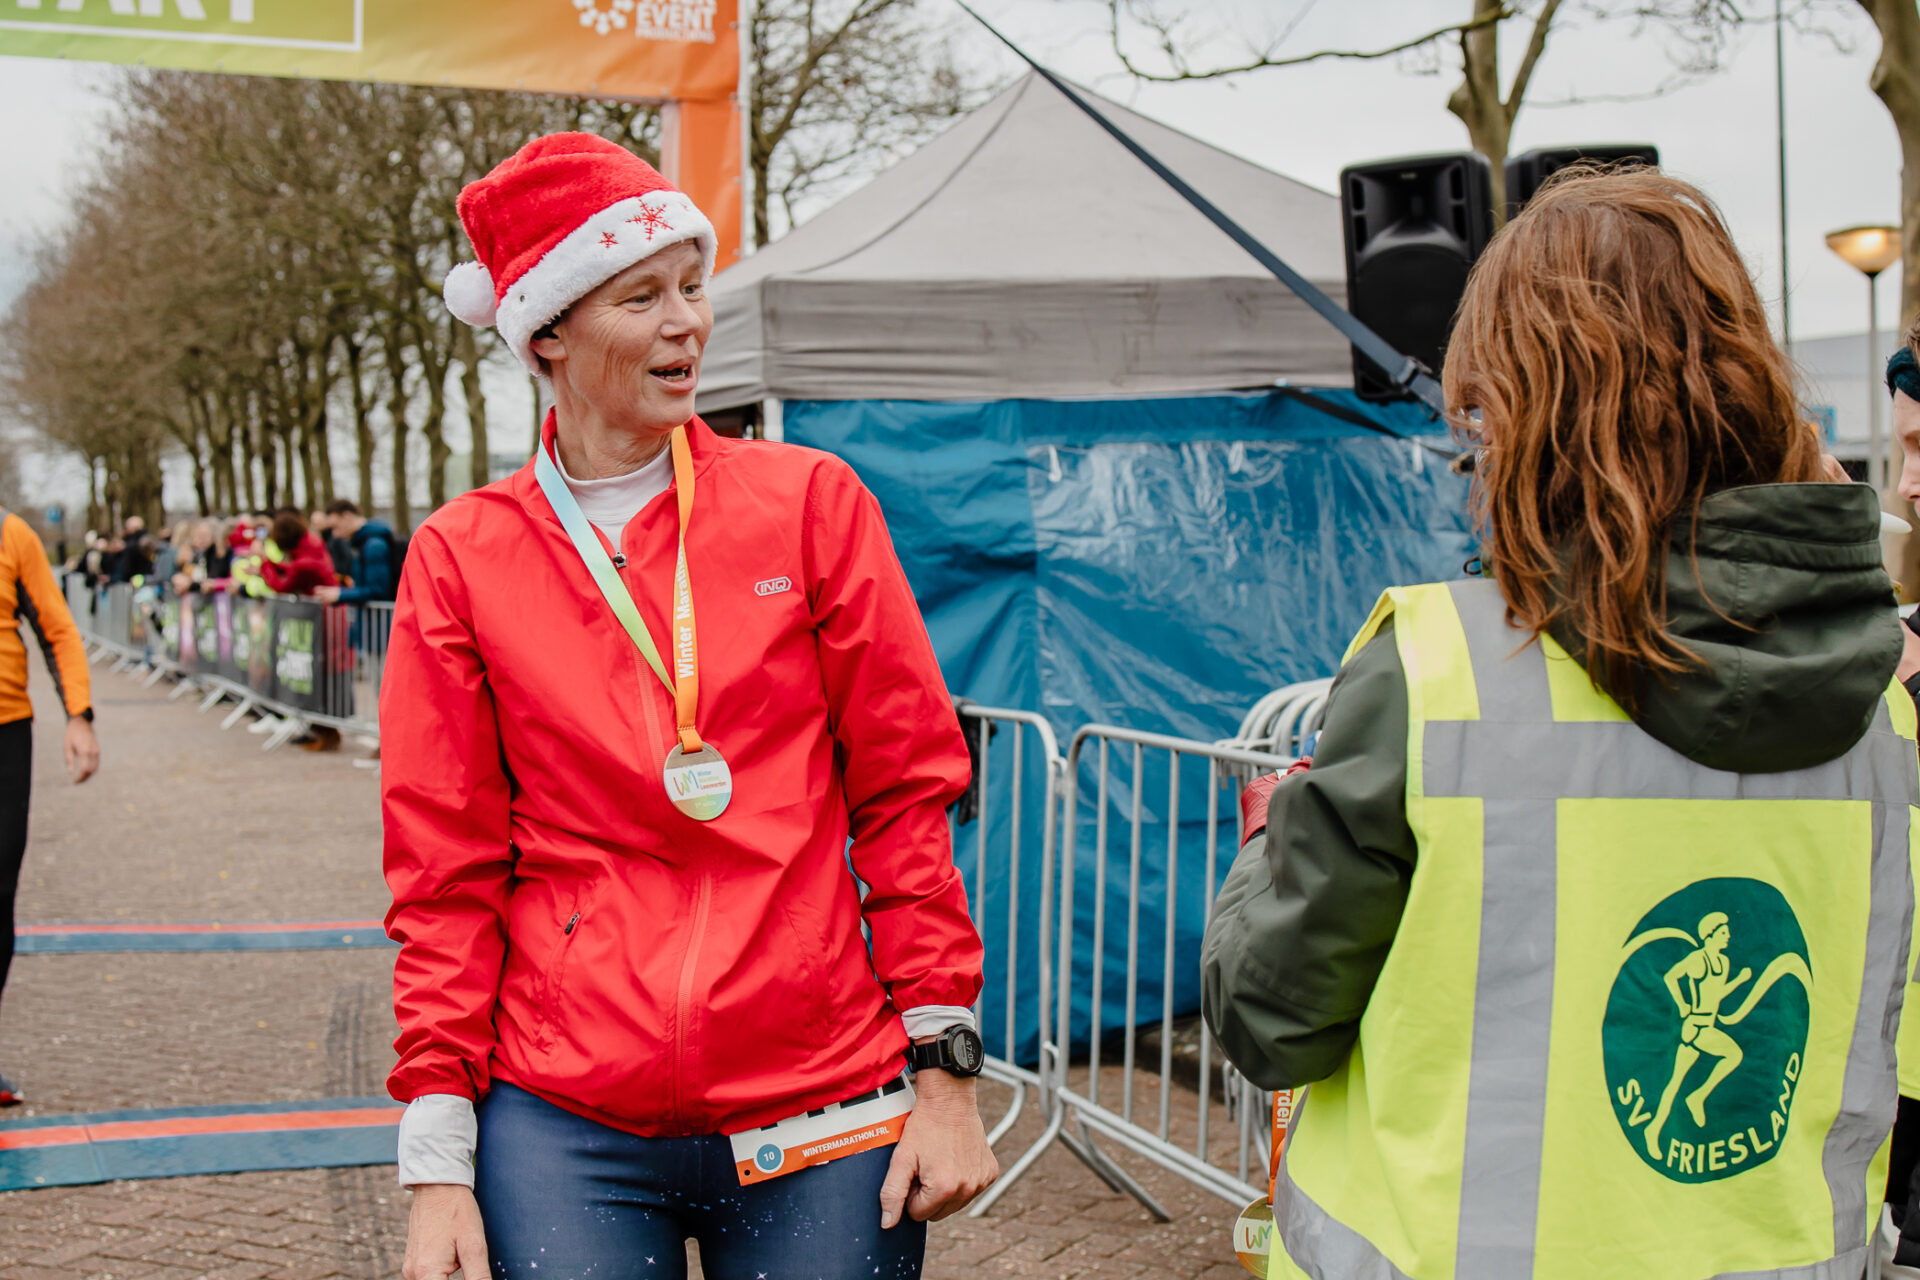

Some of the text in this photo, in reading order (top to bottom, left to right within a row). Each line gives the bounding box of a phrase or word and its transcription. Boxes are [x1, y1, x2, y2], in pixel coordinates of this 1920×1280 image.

[635, 3, 717, 30] EVENT
[760, 579, 787, 593] INQ
[679, 626, 695, 679] Winter
[1616, 1052, 1800, 1174] SV FRIESLAND
[763, 1151, 776, 1162] 10
[801, 1125, 890, 1158] WINTERMARATHON.FRL
